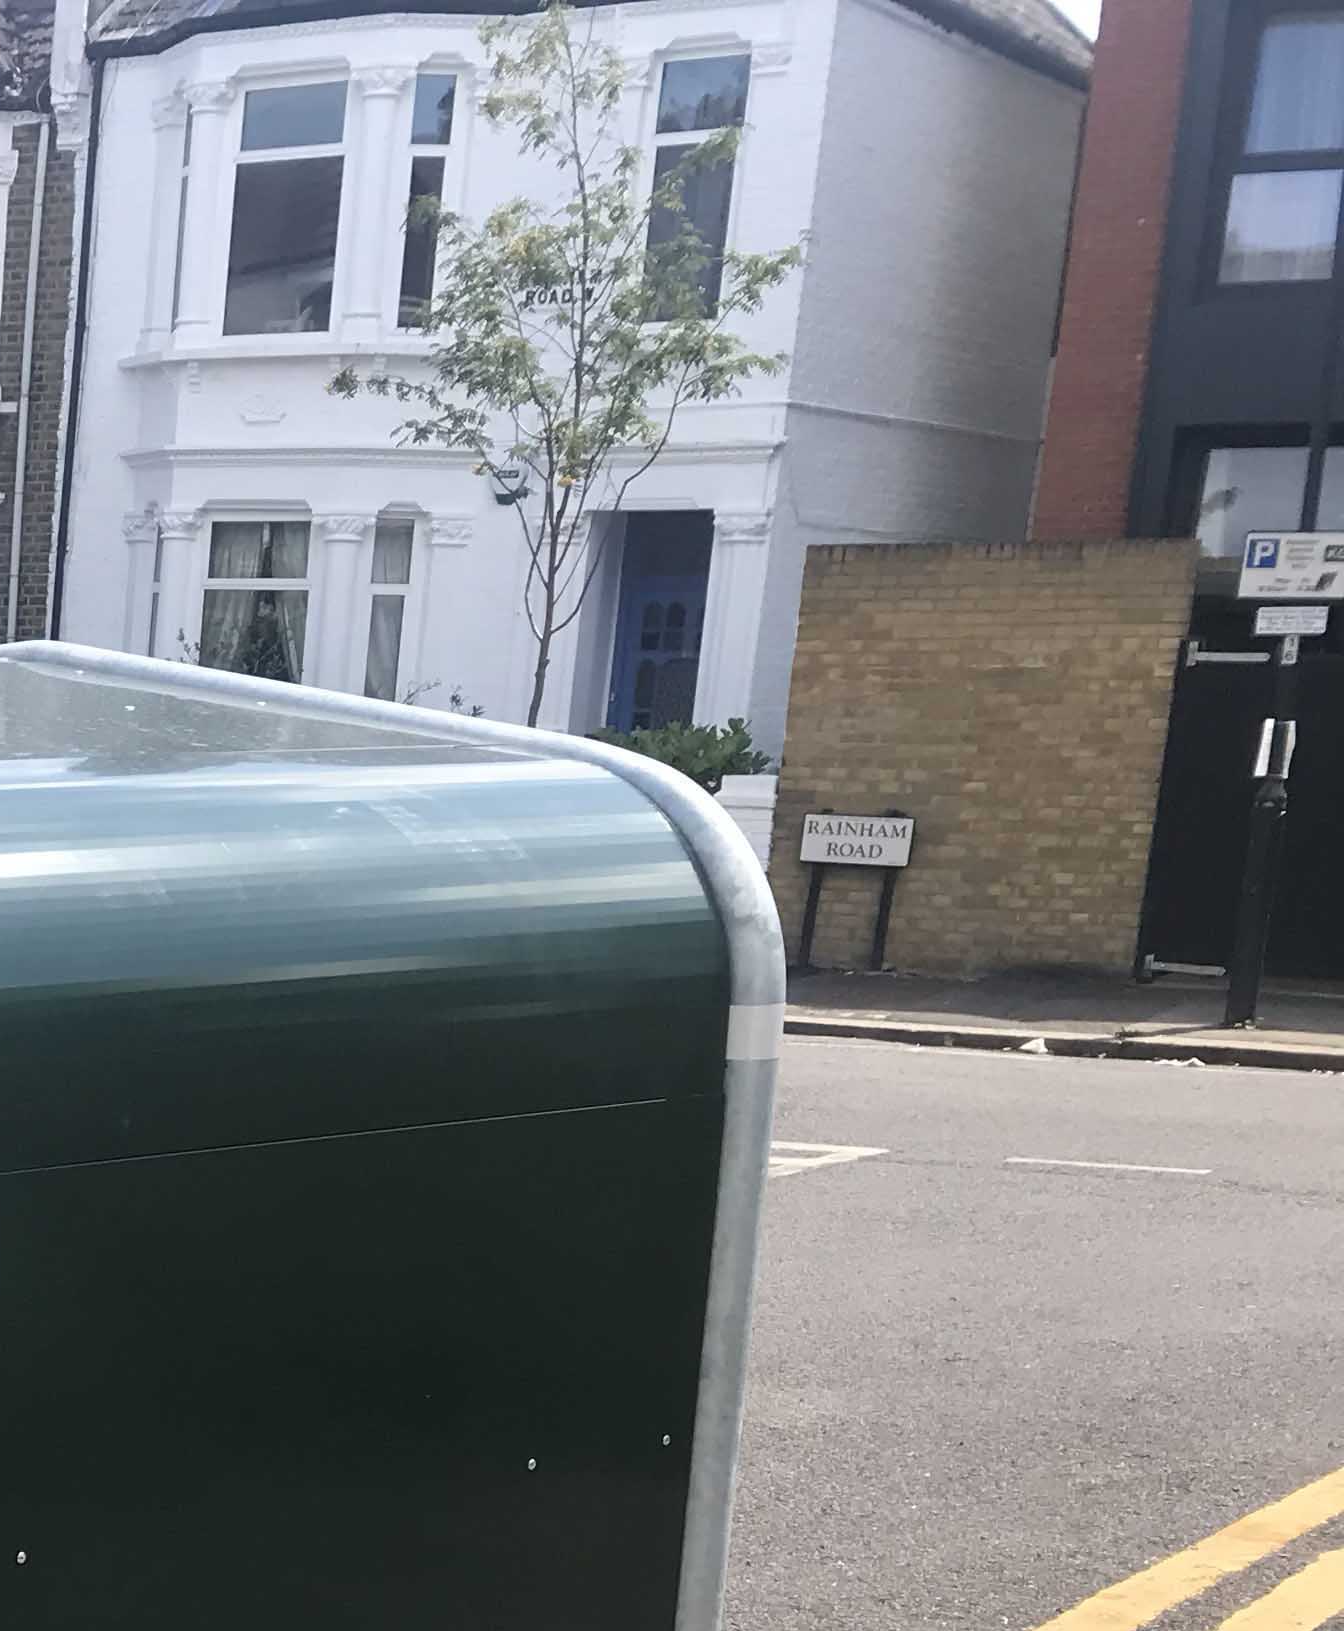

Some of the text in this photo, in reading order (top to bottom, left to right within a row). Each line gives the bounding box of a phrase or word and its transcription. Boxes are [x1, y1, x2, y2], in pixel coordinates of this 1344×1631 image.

[1253, 541, 1275, 567] P
[807, 820, 907, 839] RAINHAM
[826, 841, 883, 859] ROAD
